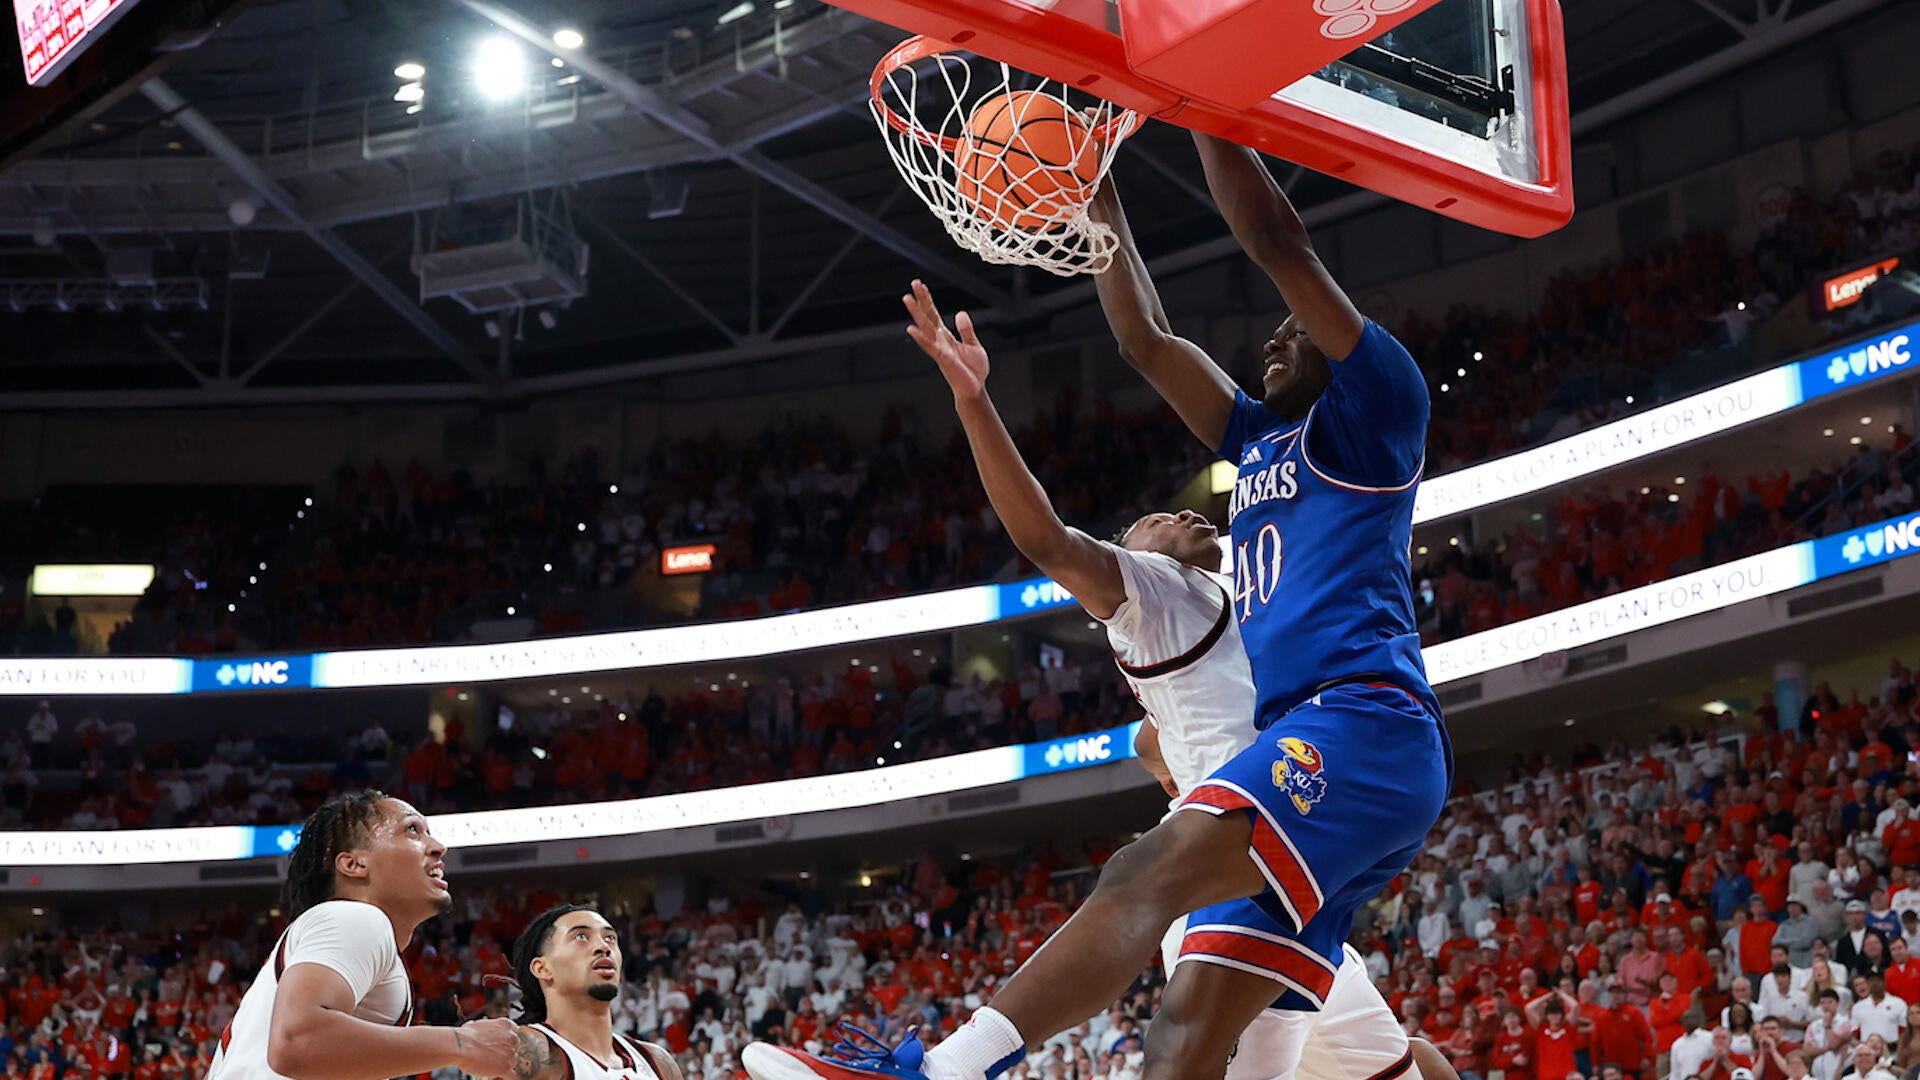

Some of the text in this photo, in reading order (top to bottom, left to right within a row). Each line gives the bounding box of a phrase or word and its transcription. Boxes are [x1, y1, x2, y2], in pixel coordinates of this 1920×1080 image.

[1866, 335, 1911, 374] NC
[1650, 408, 1696, 441] FOR
[1228, 459, 1299, 526] ANSAS
[1234, 522, 1285, 625] 40
[1515, 621, 1560, 652] GOT
[1568, 617, 1581, 634] A
[1589, 598, 1649, 632] PLAN
[1657, 581, 1704, 613] FOR
[252, 662, 287, 683] NC
[1077, 734, 1112, 763] NC
[1292, 770, 1313, 790] KU
